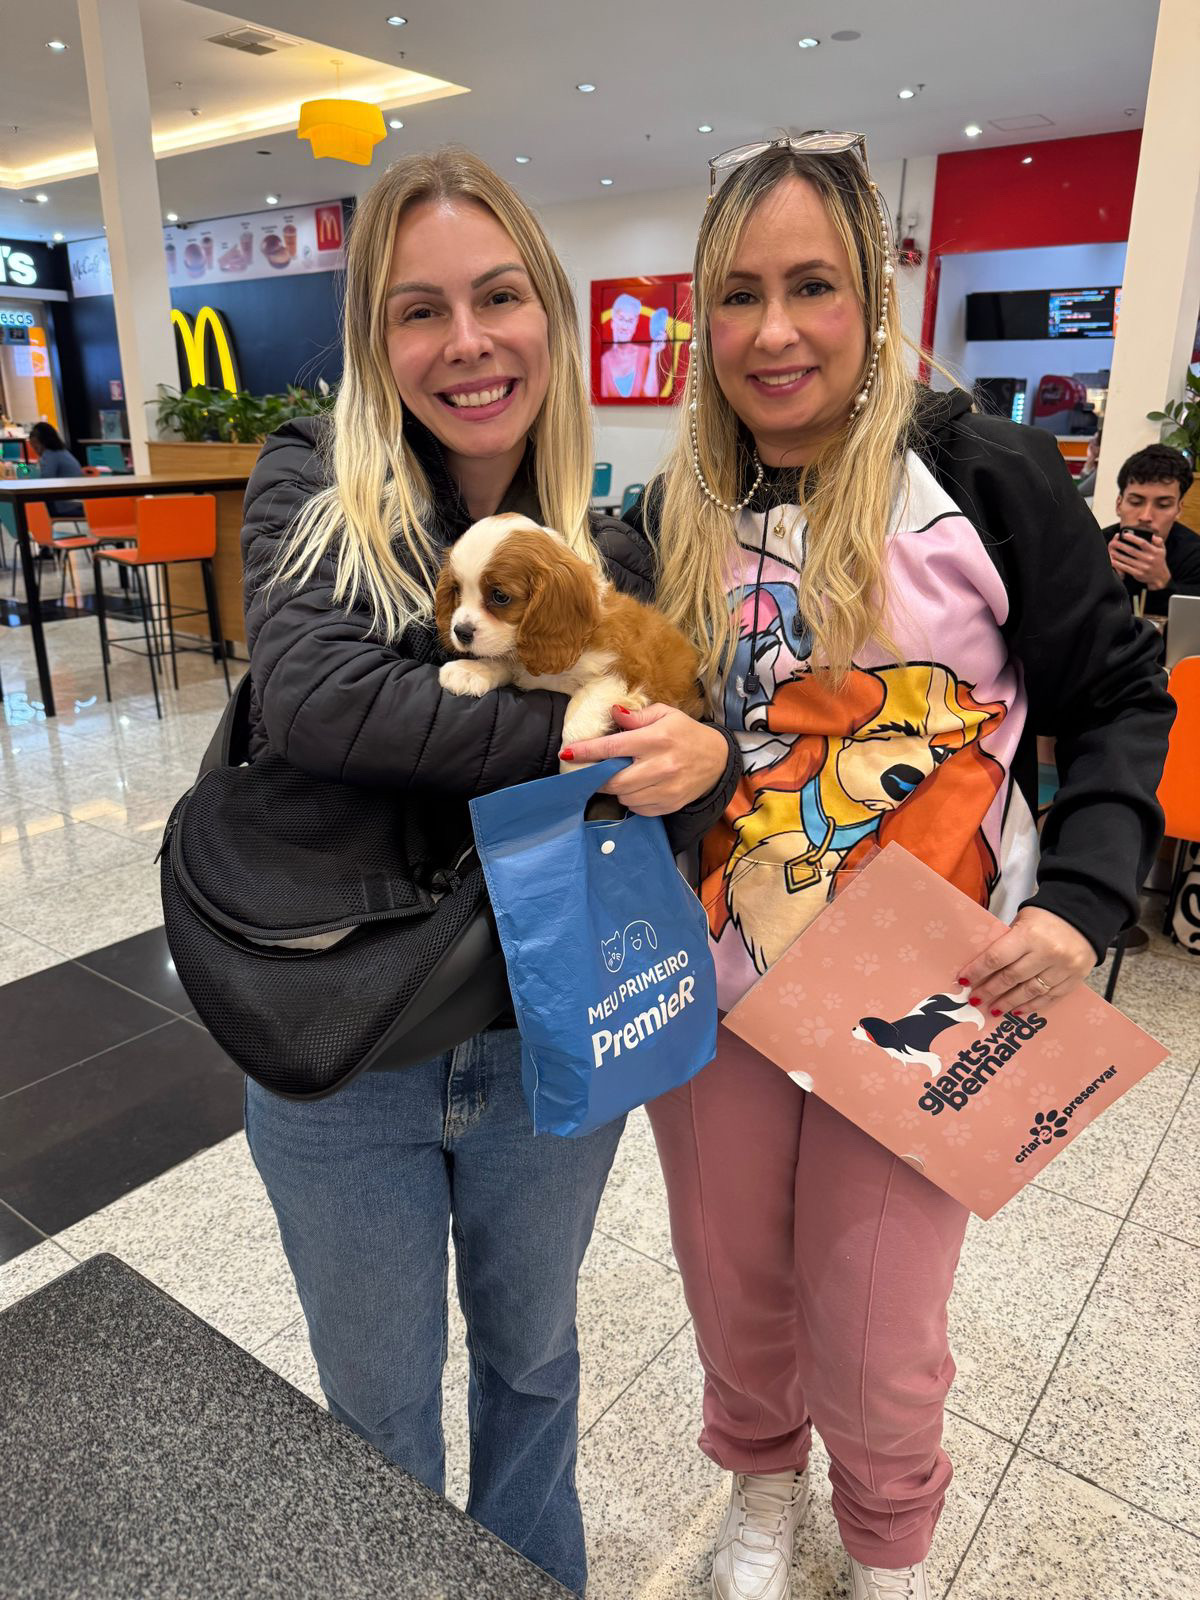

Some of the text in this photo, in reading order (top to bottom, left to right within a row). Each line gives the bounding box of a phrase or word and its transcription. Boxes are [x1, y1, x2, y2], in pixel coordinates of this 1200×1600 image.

[587, 950, 688, 1025] MEU PRIMEIRO
[918, 1011, 1021, 1115] giants well
[945, 1012, 1048, 1112] bernards
[1015, 1136, 1041, 1163] criar
[1063, 1065, 1117, 1117] preservar
